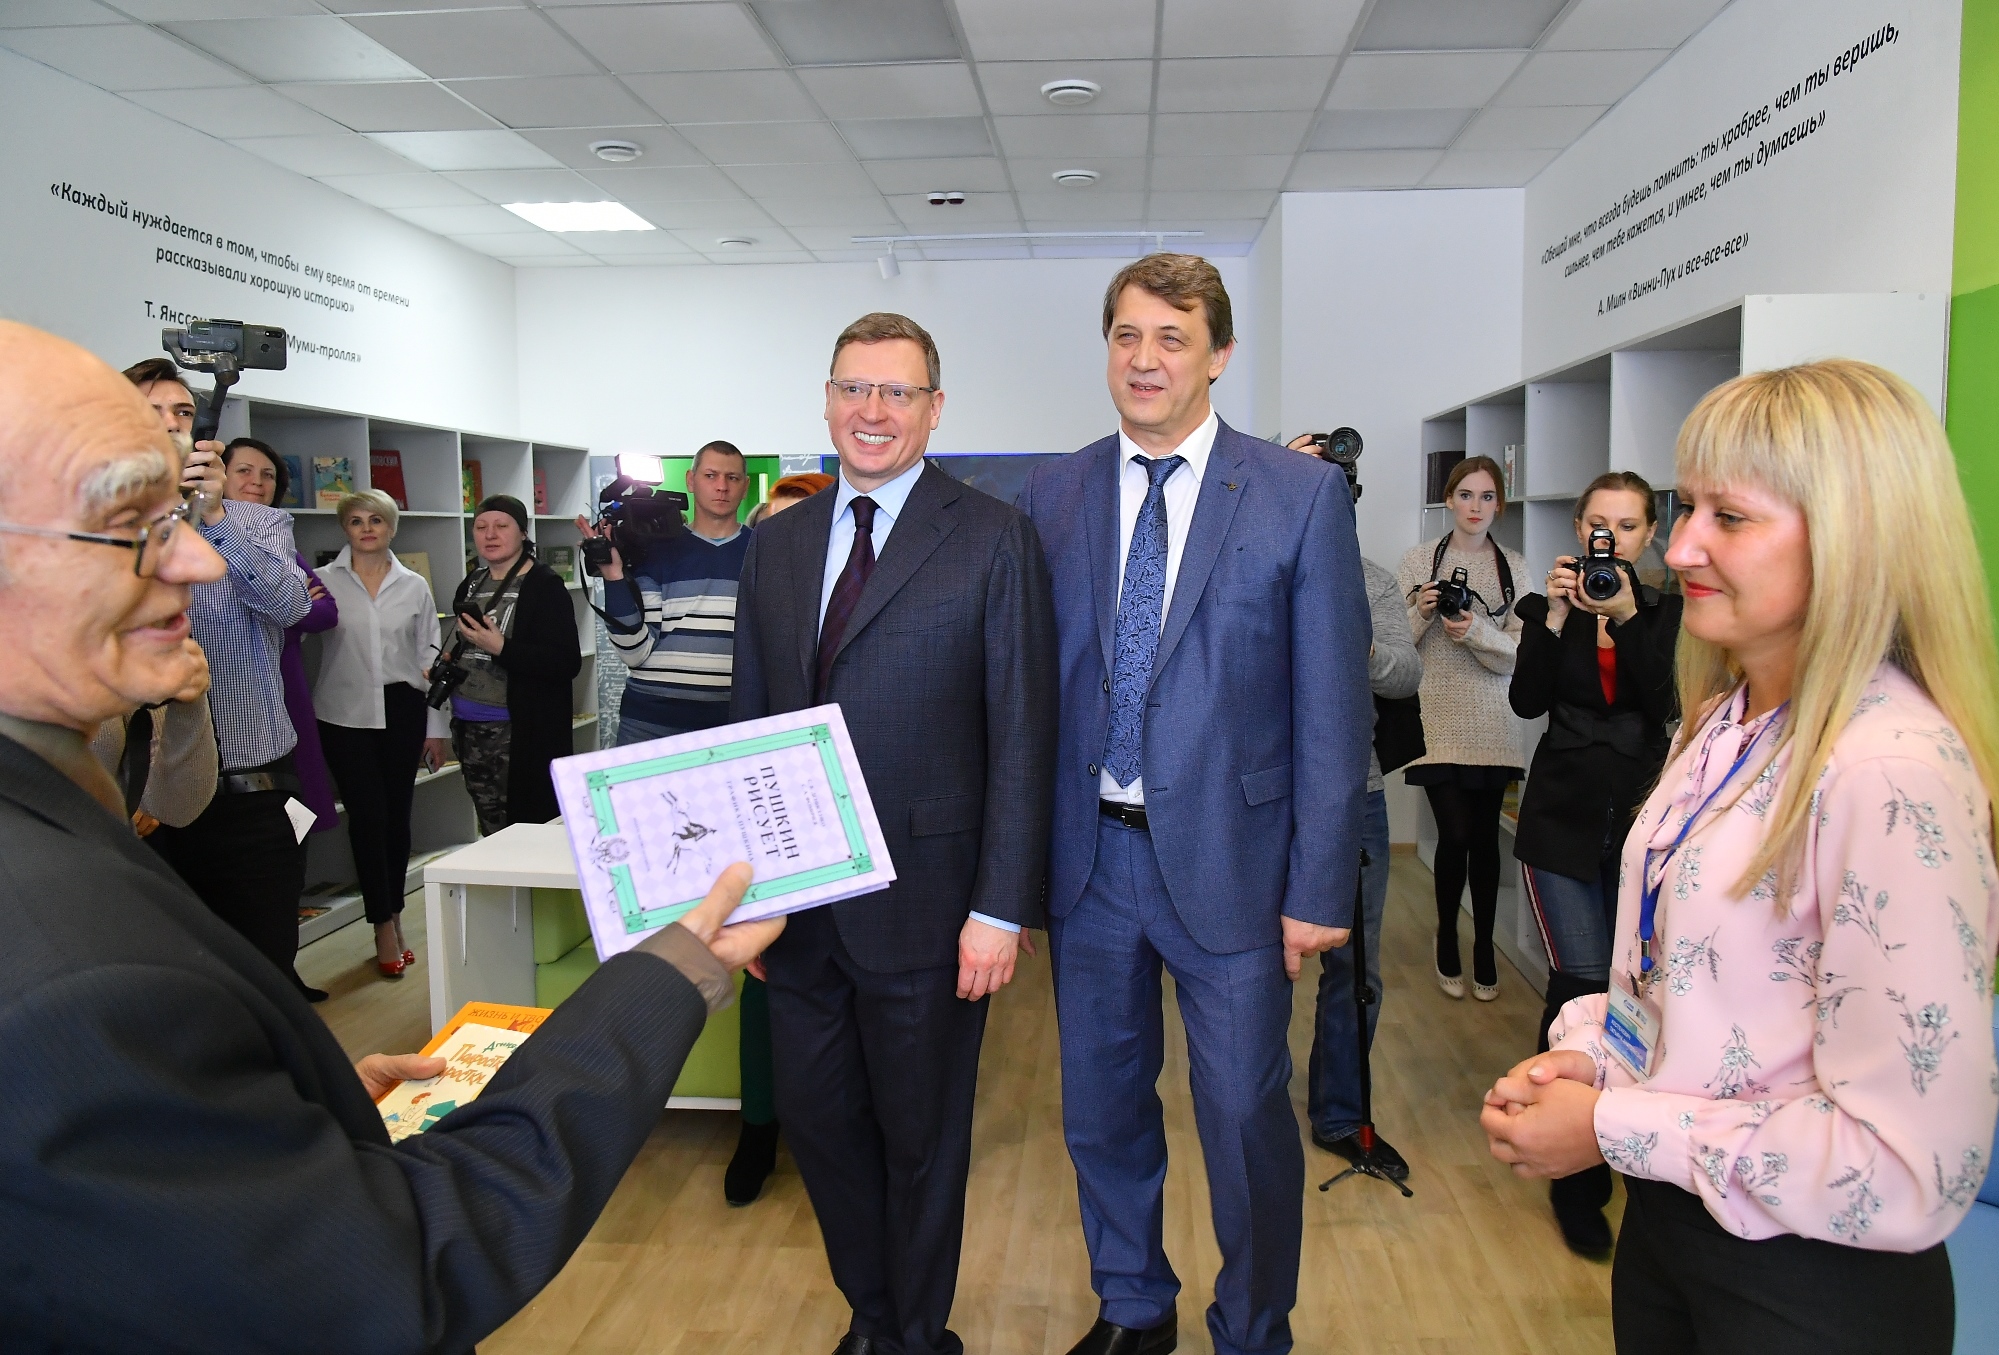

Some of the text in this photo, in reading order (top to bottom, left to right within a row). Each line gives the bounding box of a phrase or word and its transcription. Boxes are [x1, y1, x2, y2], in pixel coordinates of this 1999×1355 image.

[1583, 220, 1598, 238] что
[1598, 202, 1621, 230] всегда
[1622, 184, 1652, 216] будешь
[1652, 152, 1699, 194] помнить:
[1700, 137, 1719, 163] ты
[1720, 104, 1771, 151] храбрее,
[1775, 82, 1800, 113] чем
[1804, 63, 1830, 96] ты
[1833, 22, 1899, 77] веришь,
[1564, 110, 1826, 278] сильнее, чем тебе кажется, и умнее, чем ты думаешь»
[51, 182, 410, 307] «Каждый нуждается в том, чтобы ему время от времени
[156, 247, 355, 313] рассказывали хорошую историю»
[1597, 232, 1749, 316] А. Милн «Винни-Пух и все-все-все»
[144, 300, 155, 318] Т.
[160, 305, 208, 325] Янсс
[726, 780, 754, 862] ГРАФИКА ПУШКИНА
[743, 776, 781, 857] РИСУЕТ
[760, 766, 800, 859] ПУШКИН
[468, 1009, 545, 1023] ЖИЗНЬ И ТВО
[449, 1043, 507, 1072] Подростк
